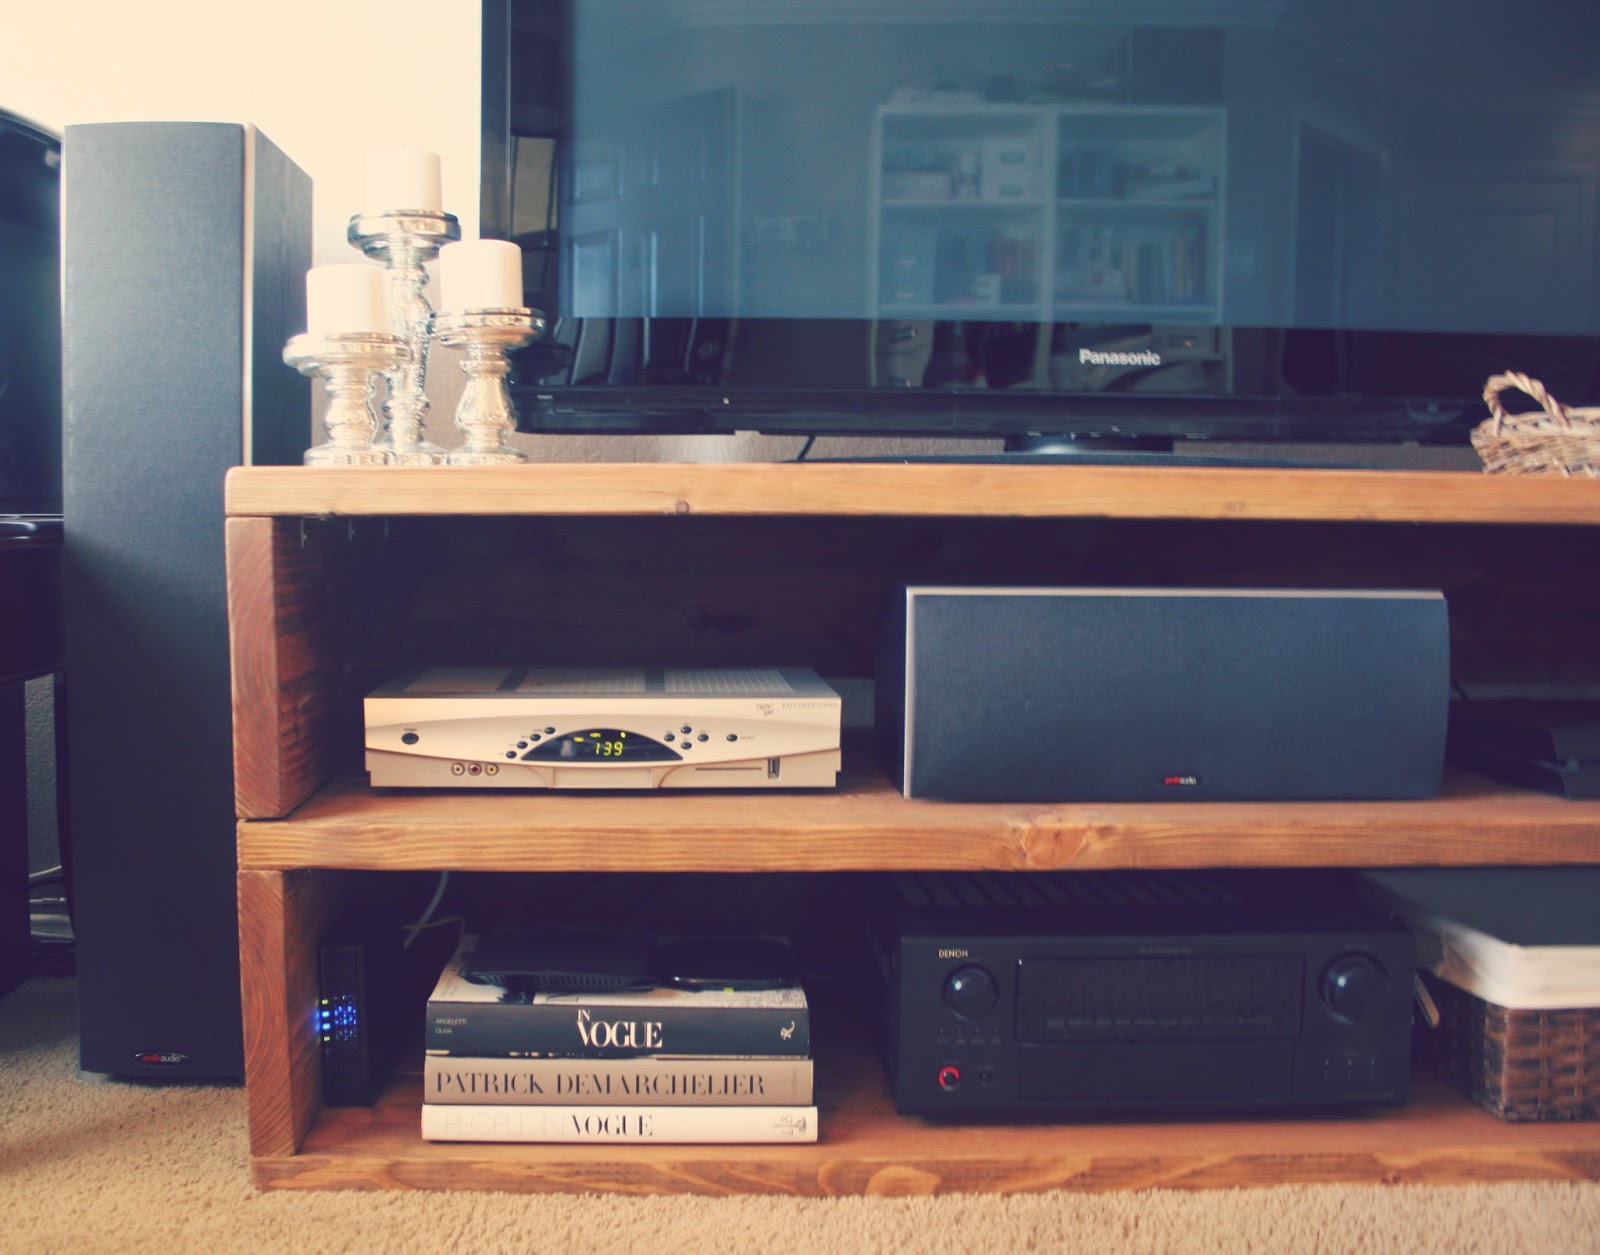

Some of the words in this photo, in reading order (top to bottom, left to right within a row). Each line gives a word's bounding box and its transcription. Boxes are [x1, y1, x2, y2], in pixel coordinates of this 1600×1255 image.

[1079, 348, 1161, 366] Panasonic
[595, 741, 623, 756] 139
[938, 948, 969, 959] DENON
[577, 1009, 591, 1022] IN
[576, 1021, 663, 1048] VOGUE
[436, 1071, 544, 1095] PATRICK
[556, 1073, 765, 1096] DEMARCHELIER
[445, 1111, 536, 1137] PEOPLE
[541, 1112, 565, 1137] IN
[571, 1114, 653, 1137] VOGUE
